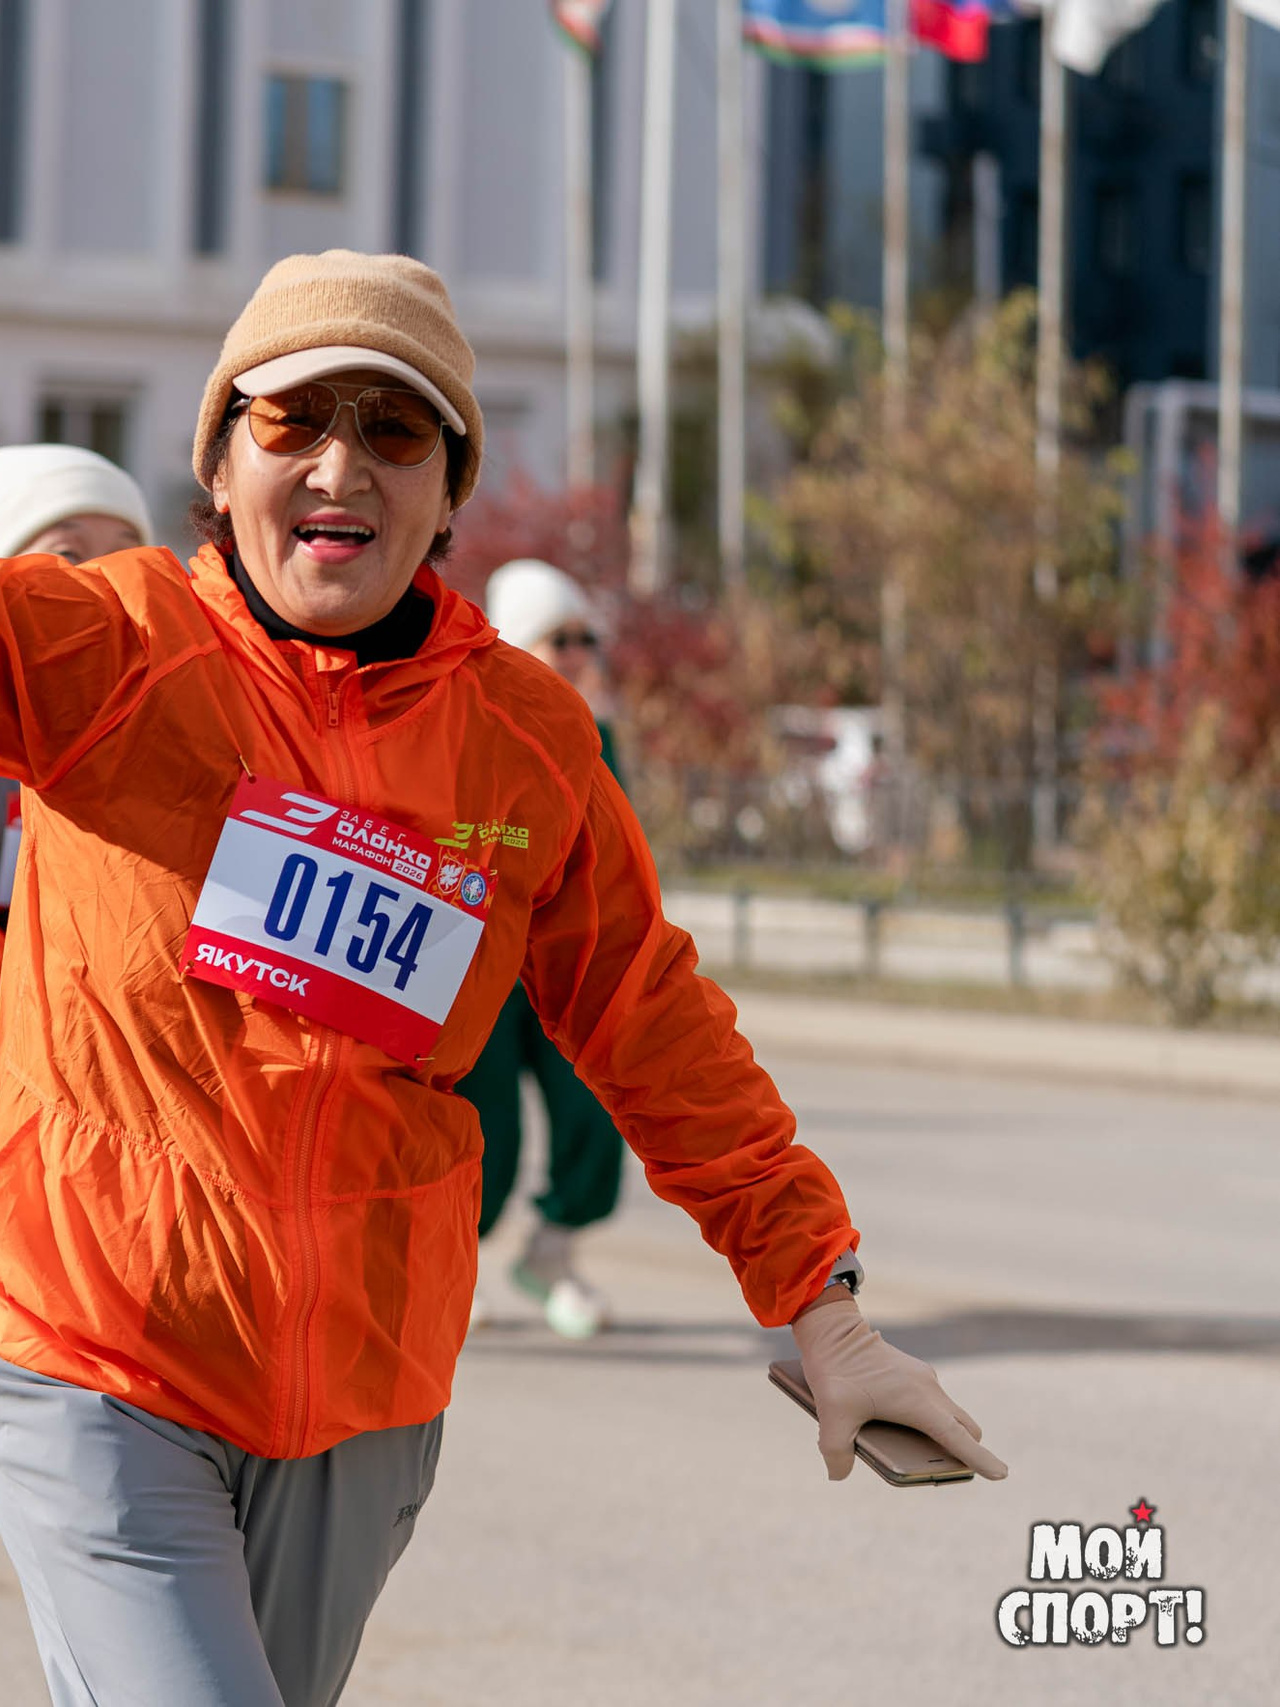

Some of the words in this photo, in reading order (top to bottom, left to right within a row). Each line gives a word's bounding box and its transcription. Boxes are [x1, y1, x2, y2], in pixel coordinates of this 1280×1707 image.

[336, 820, 432, 870] ОЛОНХО
[340, 810, 407, 841] ЗАБЕГ
[332, 836, 392, 867] МАРАФОН
[395, 862, 423, 880] 2026
[264, 853, 433, 992] 0154
[195, 943, 311, 997] ЯКУТСК
